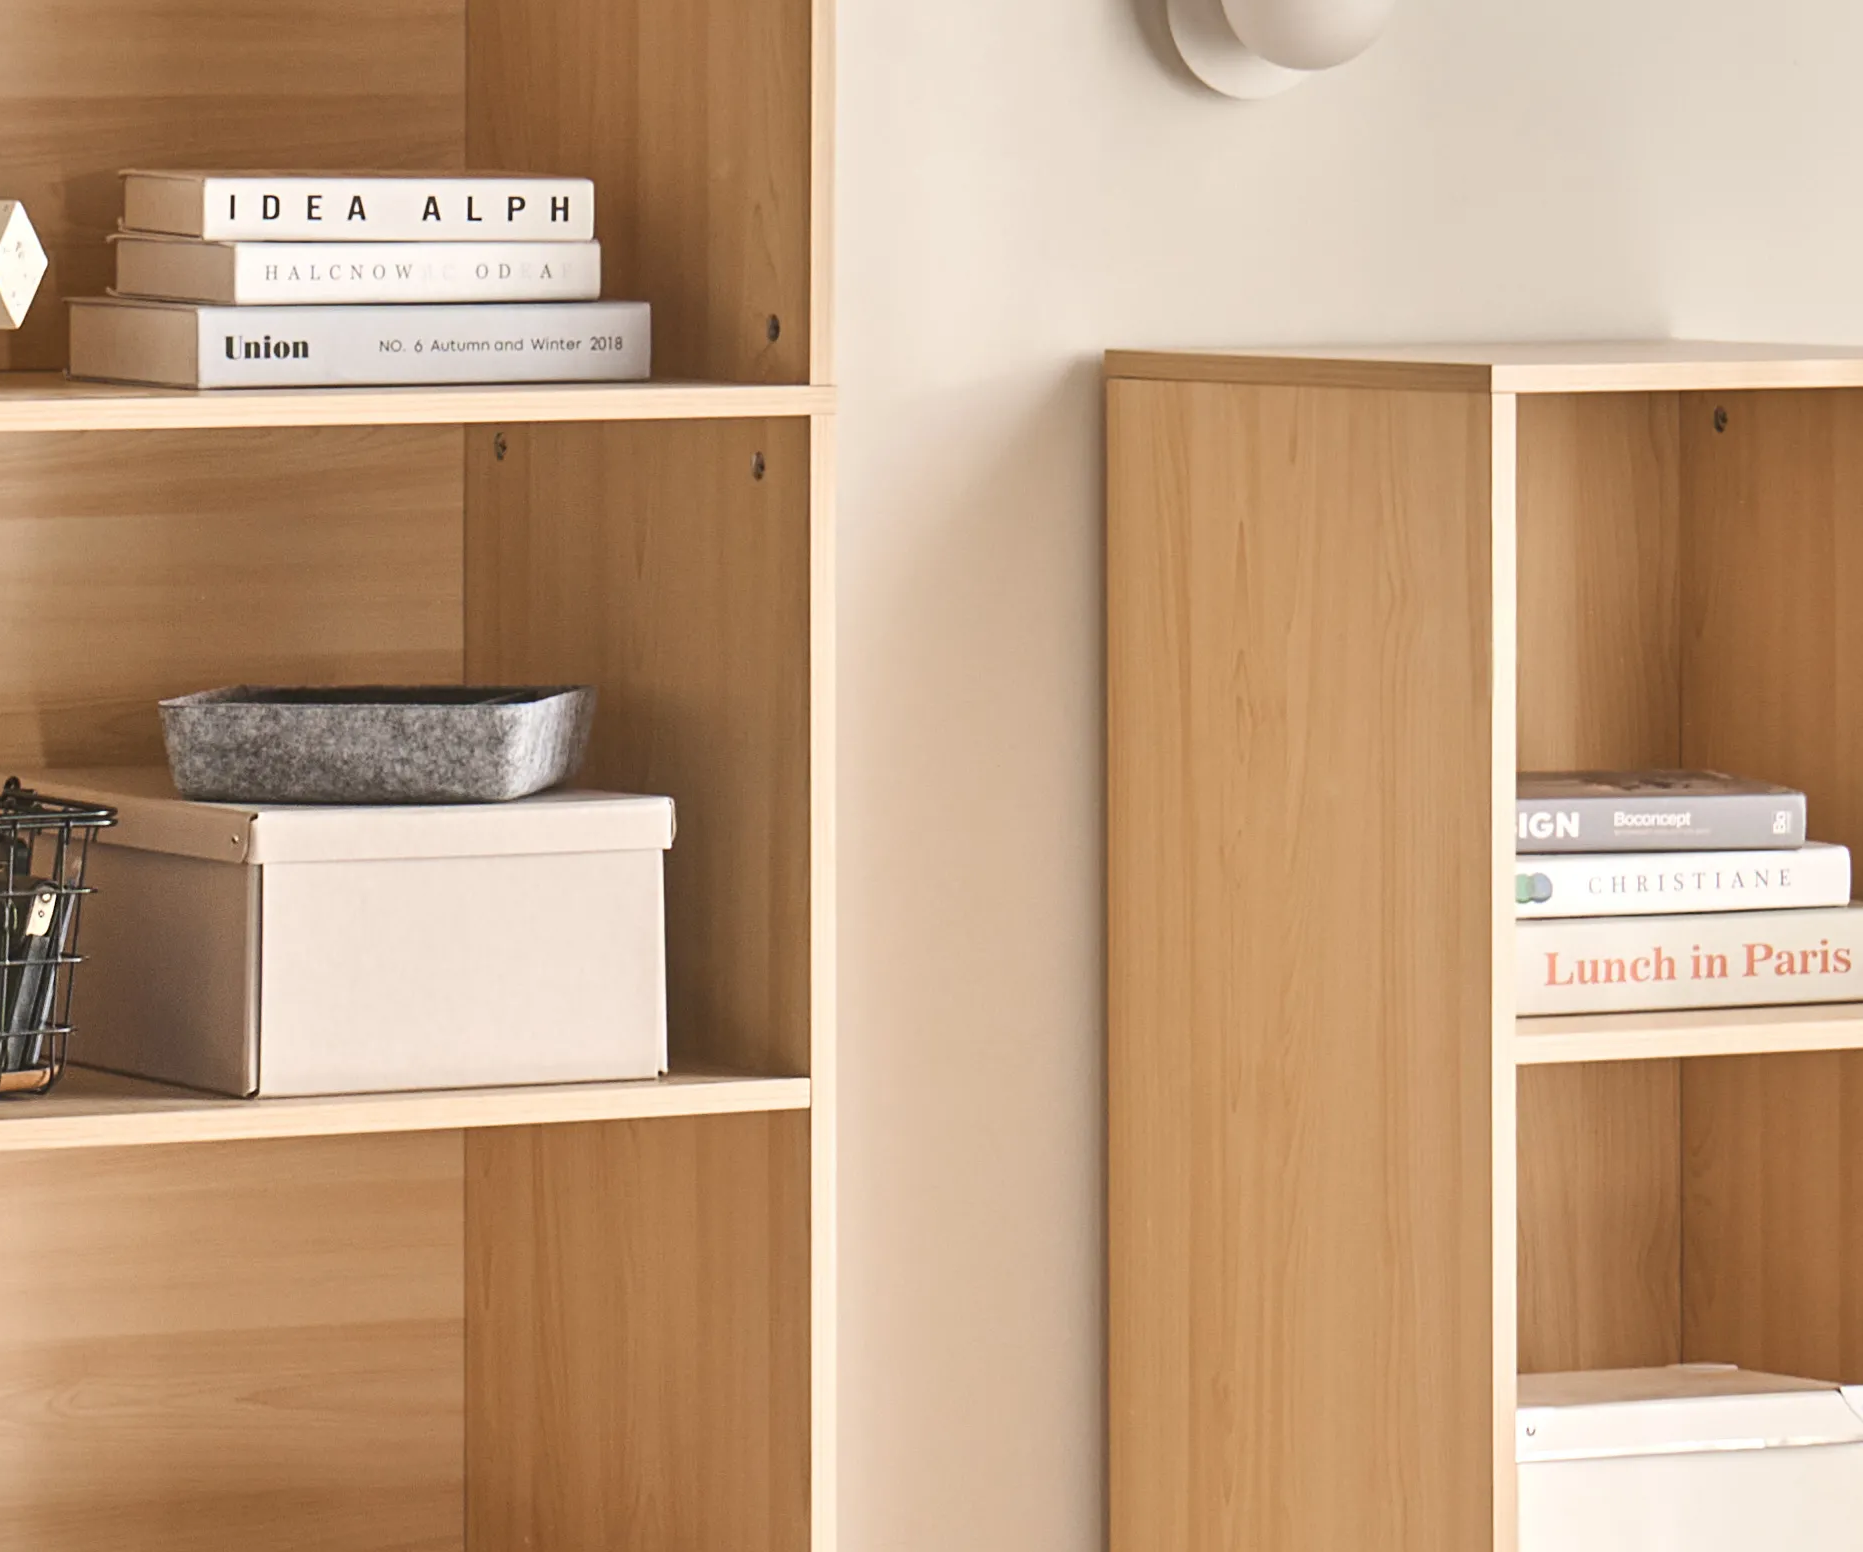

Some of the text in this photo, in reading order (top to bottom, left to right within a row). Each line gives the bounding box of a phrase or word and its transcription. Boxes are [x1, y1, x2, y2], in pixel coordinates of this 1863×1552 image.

[228, 193, 571, 223] IDEA ALPH
[264, 262, 415, 282] HALCNOW
[223, 334, 624, 361] Union NO. 6 Autumn and Winter 2018
[1516, 810, 1581, 839] IGN
[1587, 867, 1793, 894] CHRISTIANE
[1543, 938, 1853, 986] Lunch in Paris
